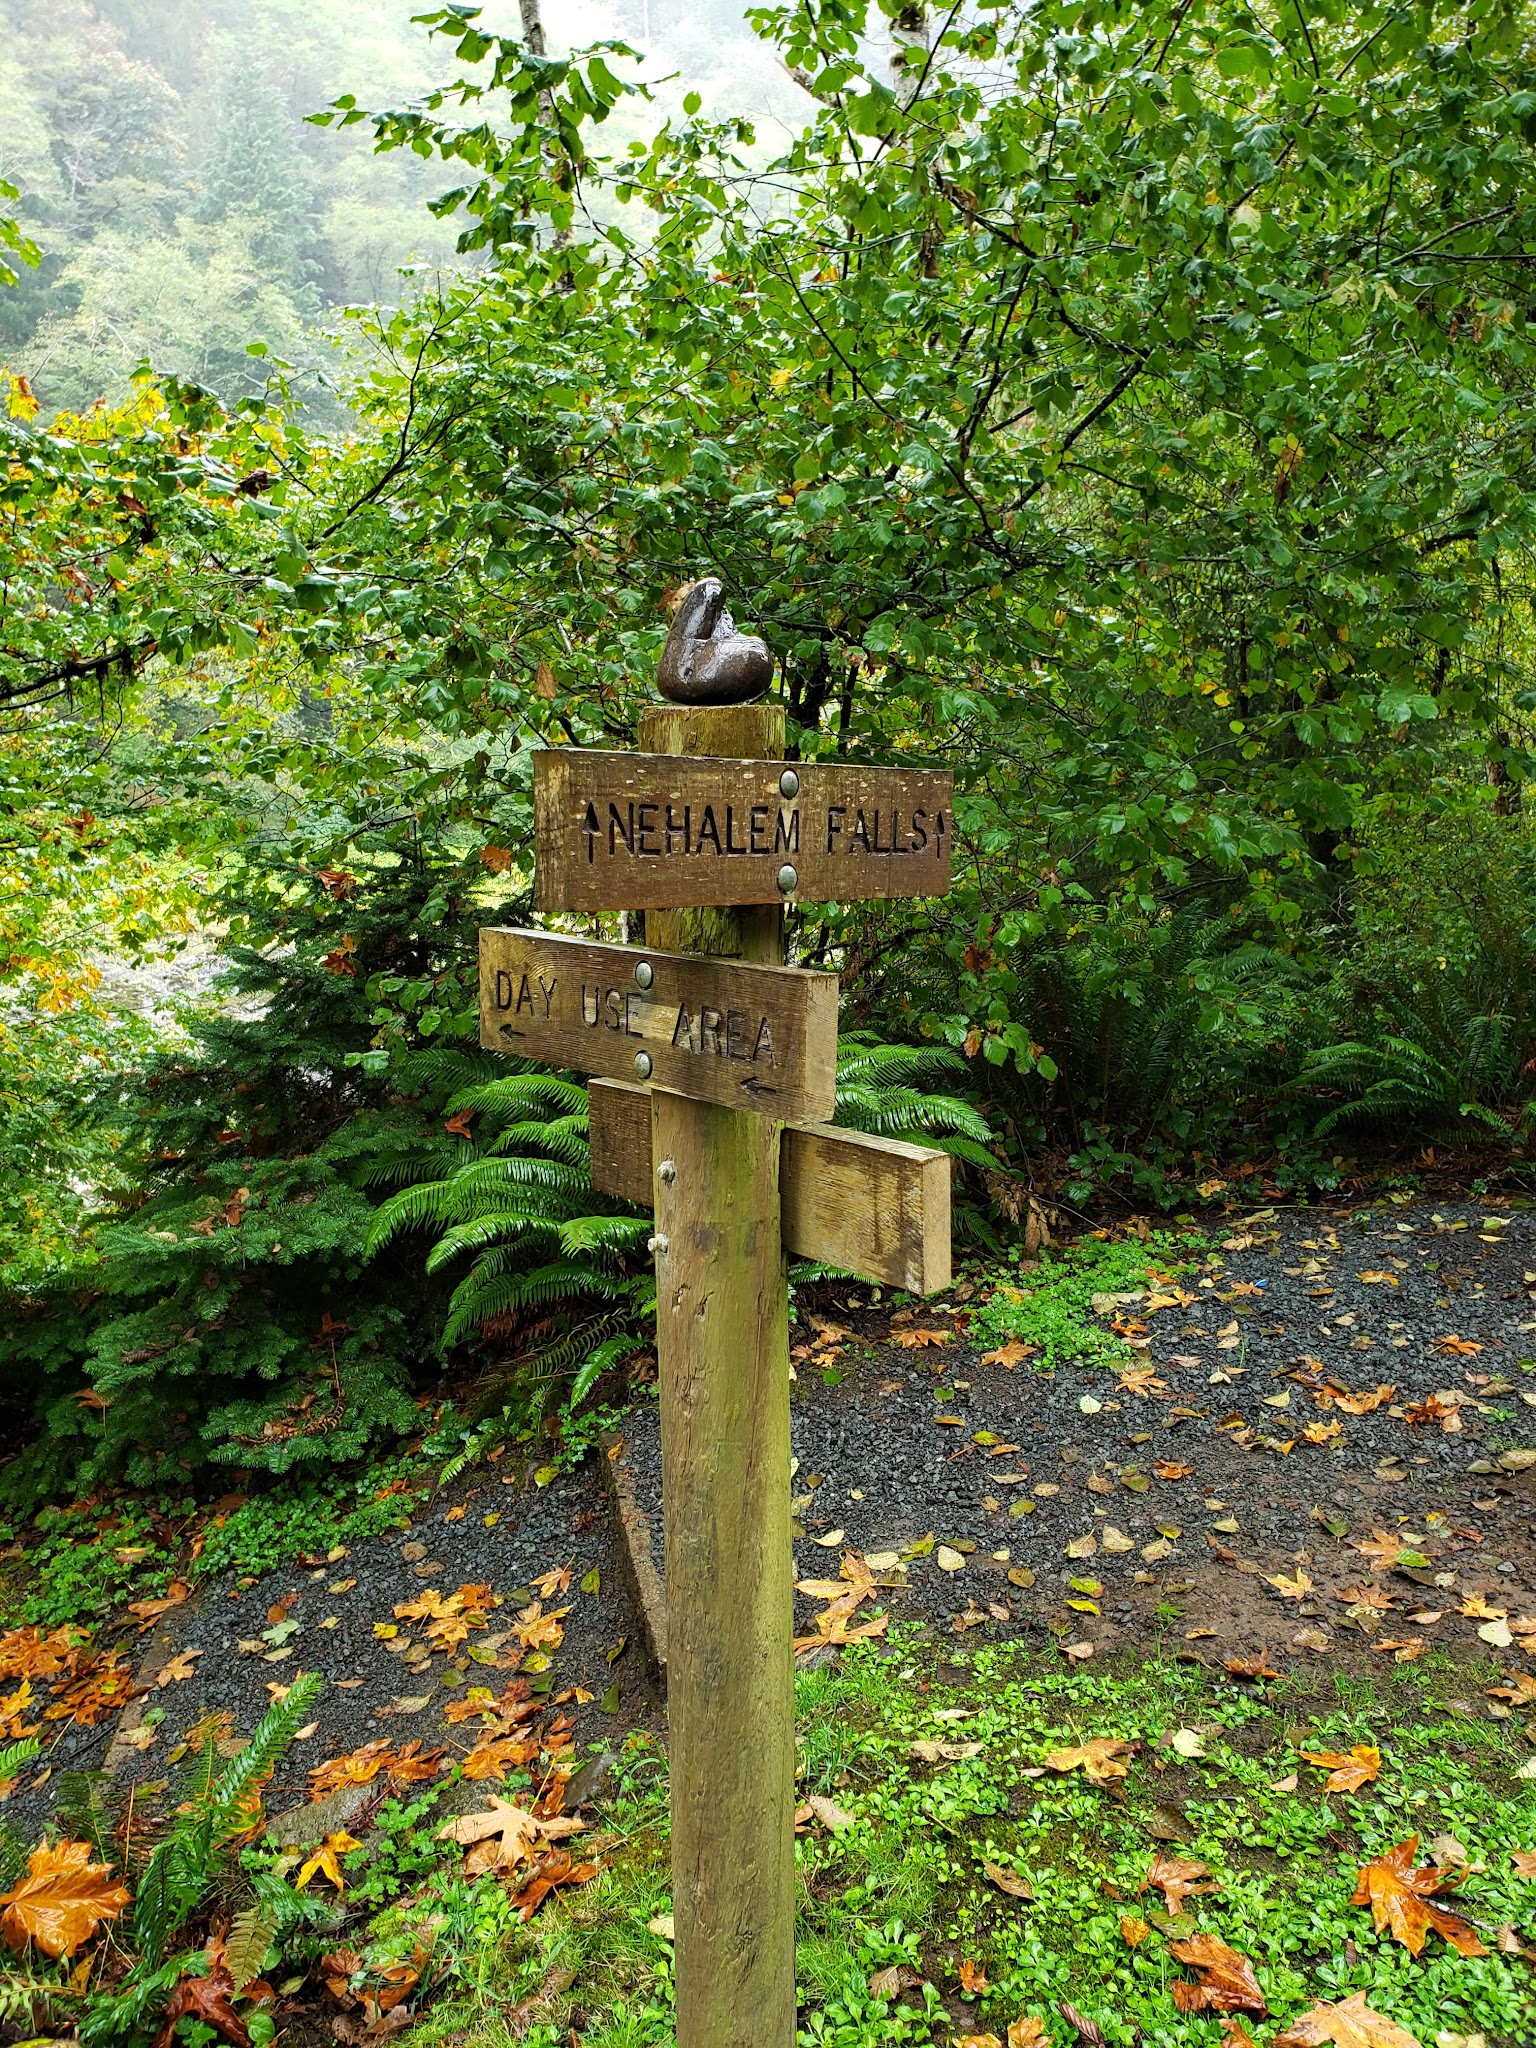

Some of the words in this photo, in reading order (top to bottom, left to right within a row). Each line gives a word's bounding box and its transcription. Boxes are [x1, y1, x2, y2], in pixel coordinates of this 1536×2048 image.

[608, 802, 800, 858] NEHALEM
[827, 806, 928, 856] FALLS
[496, 970, 558, 1019] DAY
[581, 984, 643, 1038] USE
[671, 1002, 777, 1068] AREA
